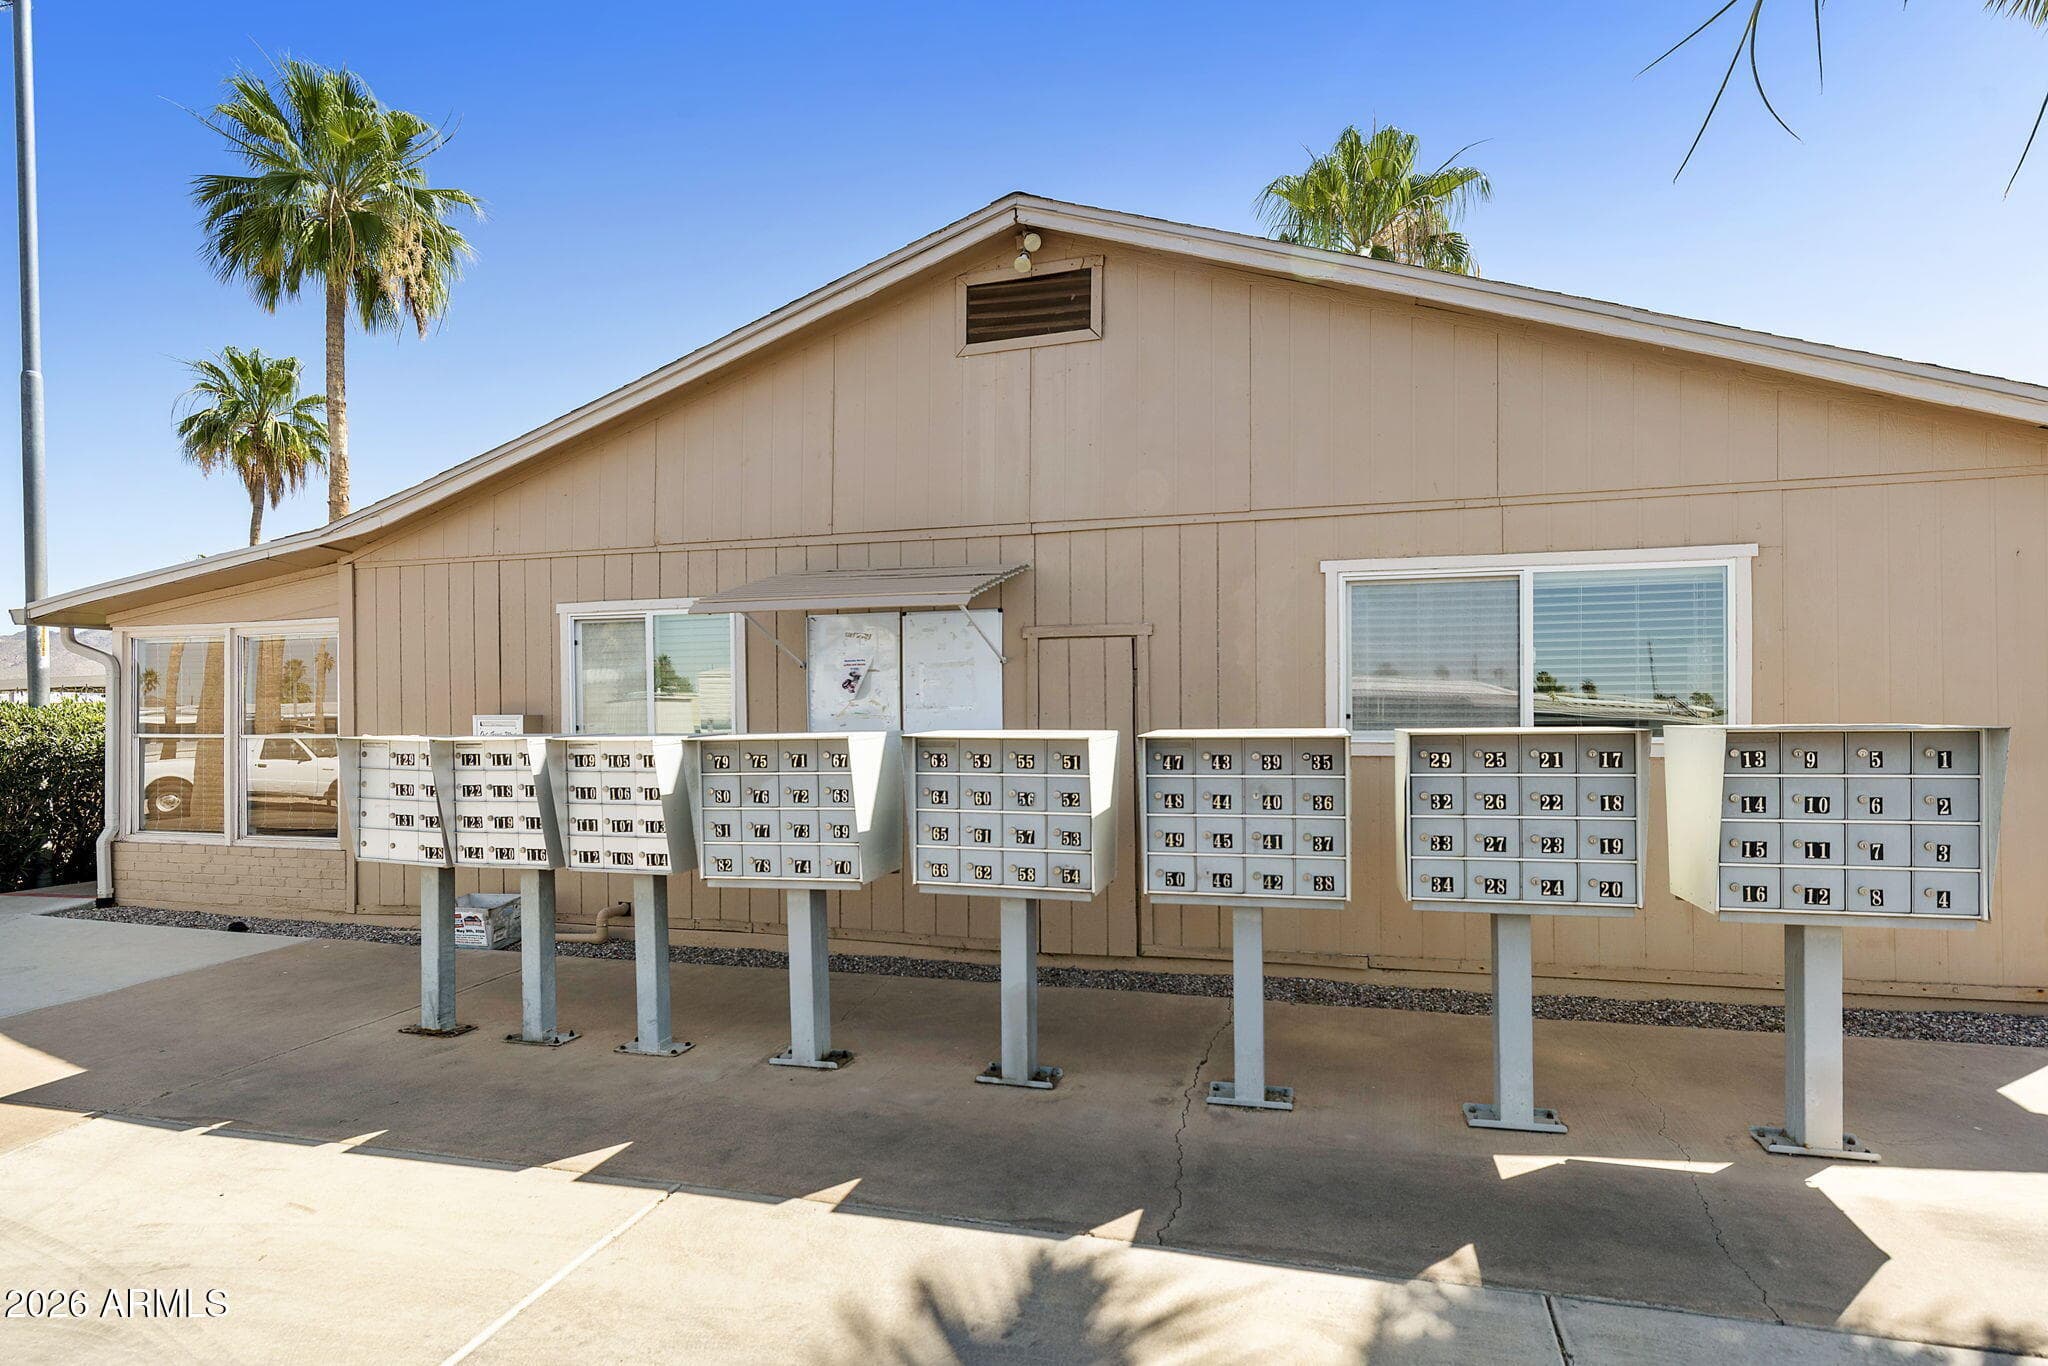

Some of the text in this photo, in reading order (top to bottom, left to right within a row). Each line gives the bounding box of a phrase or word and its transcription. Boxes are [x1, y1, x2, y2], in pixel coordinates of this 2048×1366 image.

[396, 754, 414, 766] 129
[461, 754, 480, 766] 121
[492, 754, 512, 765] 117
[575, 755, 595, 767] 109
[609, 755, 630, 767] 105
[714, 756, 729, 769] 79
[752, 755, 767, 768] 75
[792, 754, 807, 767] 71
[832, 754, 847, 767] 67
[932, 753, 948, 767] 63
[975, 754, 991, 768] 59
[1017, 755, 1034, 769] 55
[1062, 755, 1080, 770] 51
[1165, 755, 1184, 770] 47
[1212, 755, 1231, 770] 43
[1263, 755, 1282, 770] 39
[1313, 755, 1333, 770] 35
[1431, 752, 1450, 768] 29
[1485, 752, 1505, 768] 25
[1541, 752, 1562, 768] 21
[1601, 752, 1622, 768] 17
[1743, 752, 1765, 767] 13
[1805, 752, 1816, 767] 9
[1871, 752, 1882, 767] 5
[1940, 752, 1951, 767] 1
[395, 784, 414, 796] 130
[463, 785, 482, 797] 122
[493, 785, 513, 797] 118
[576, 787, 596, 799] 110
[610, 788, 631, 800] 106
[715, 790, 730, 803] 80
[754, 790, 769, 803] 76
[793, 790, 808, 803] 72
[833, 789, 848, 802] 68
[932, 790, 948, 804] 64
[975, 792, 991, 805] 60
[1018, 792, 1034, 806] 56
[1062, 792, 1080, 807] 52
[1165, 794, 1184, 808] 48
[1213, 795, 1231, 809] 44
[1263, 795, 1282, 810] 40
[1313, 796, 1333, 811] 36
[1432, 794, 1451, 809] 32
[1485, 794, 1505, 810] 26
[1541, 794, 1562, 810] 22
[1602, 795, 1623, 811] 18
[1743, 797, 1765, 812] 14
[1807, 798, 1829, 813] 10
[1871, 798, 1881, 813] 6
[1939, 799, 1950, 814] 2
[395, 814, 413, 826] 131
[463, 816, 483, 828] 123
[494, 817, 513, 828] 119
[577, 819, 597, 831] 111
[612, 820, 632, 832] 107
[715, 824, 730, 837] 81
[754, 824, 769, 837] 77
[794, 825, 809, 838] 73
[834, 825, 849, 838] 69
[932, 827, 948, 841] 65
[975, 829, 991, 843] 61
[1017, 830, 1034, 844] 57
[1063, 831, 1081, 846] 53
[1166, 833, 1184, 847] 49
[1213, 834, 1232, 848] 45
[1263, 835, 1282, 849] 41
[1313, 836, 1333, 851] 37
[1432, 835, 1451, 851] 33
[1485, 836, 1505, 852] 27
[1543, 837, 1563, 853] 23
[425, 847, 444, 859] 128
[464, 847, 483, 859] 124
[495, 847, 514, 859] 120
[1601, 838, 1622, 854] 19
[1744, 842, 1766, 857] 15
[1807, 843, 1829, 858] 11
[1871, 844, 1882, 859] 7
[527, 849, 546, 861] 116
[578, 851, 599, 863] 112
[612, 853, 633, 865] 108
[647, 854, 667, 866] 104
[1938, 846, 1949, 861] 3
[717, 859, 732, 871] 82
[755, 860, 770, 872] 78
[796, 860, 811, 873] 74
[836, 861, 851, 874] 70
[932, 864, 948, 877] 66
[975, 866, 991, 879] 62
[1018, 868, 1035, 882] 58
[1062, 869, 1080, 884] 54
[1166, 872, 1185, 887] 50
[1213, 873, 1232, 888] 46
[1264, 875, 1283, 890] 42
[1314, 876, 1334, 891] 38
[1433, 877, 1452, 892] 34
[1486, 878, 1505, 894] 28
[1542, 880, 1563, 896] 24
[1601, 882, 1621, 898] 20
[1744, 887, 1766, 901] 16
[1807, 889, 1829, 904] 12
[1871, 891, 1882, 905] 8
[1938, 892, 1949, 907] 4
